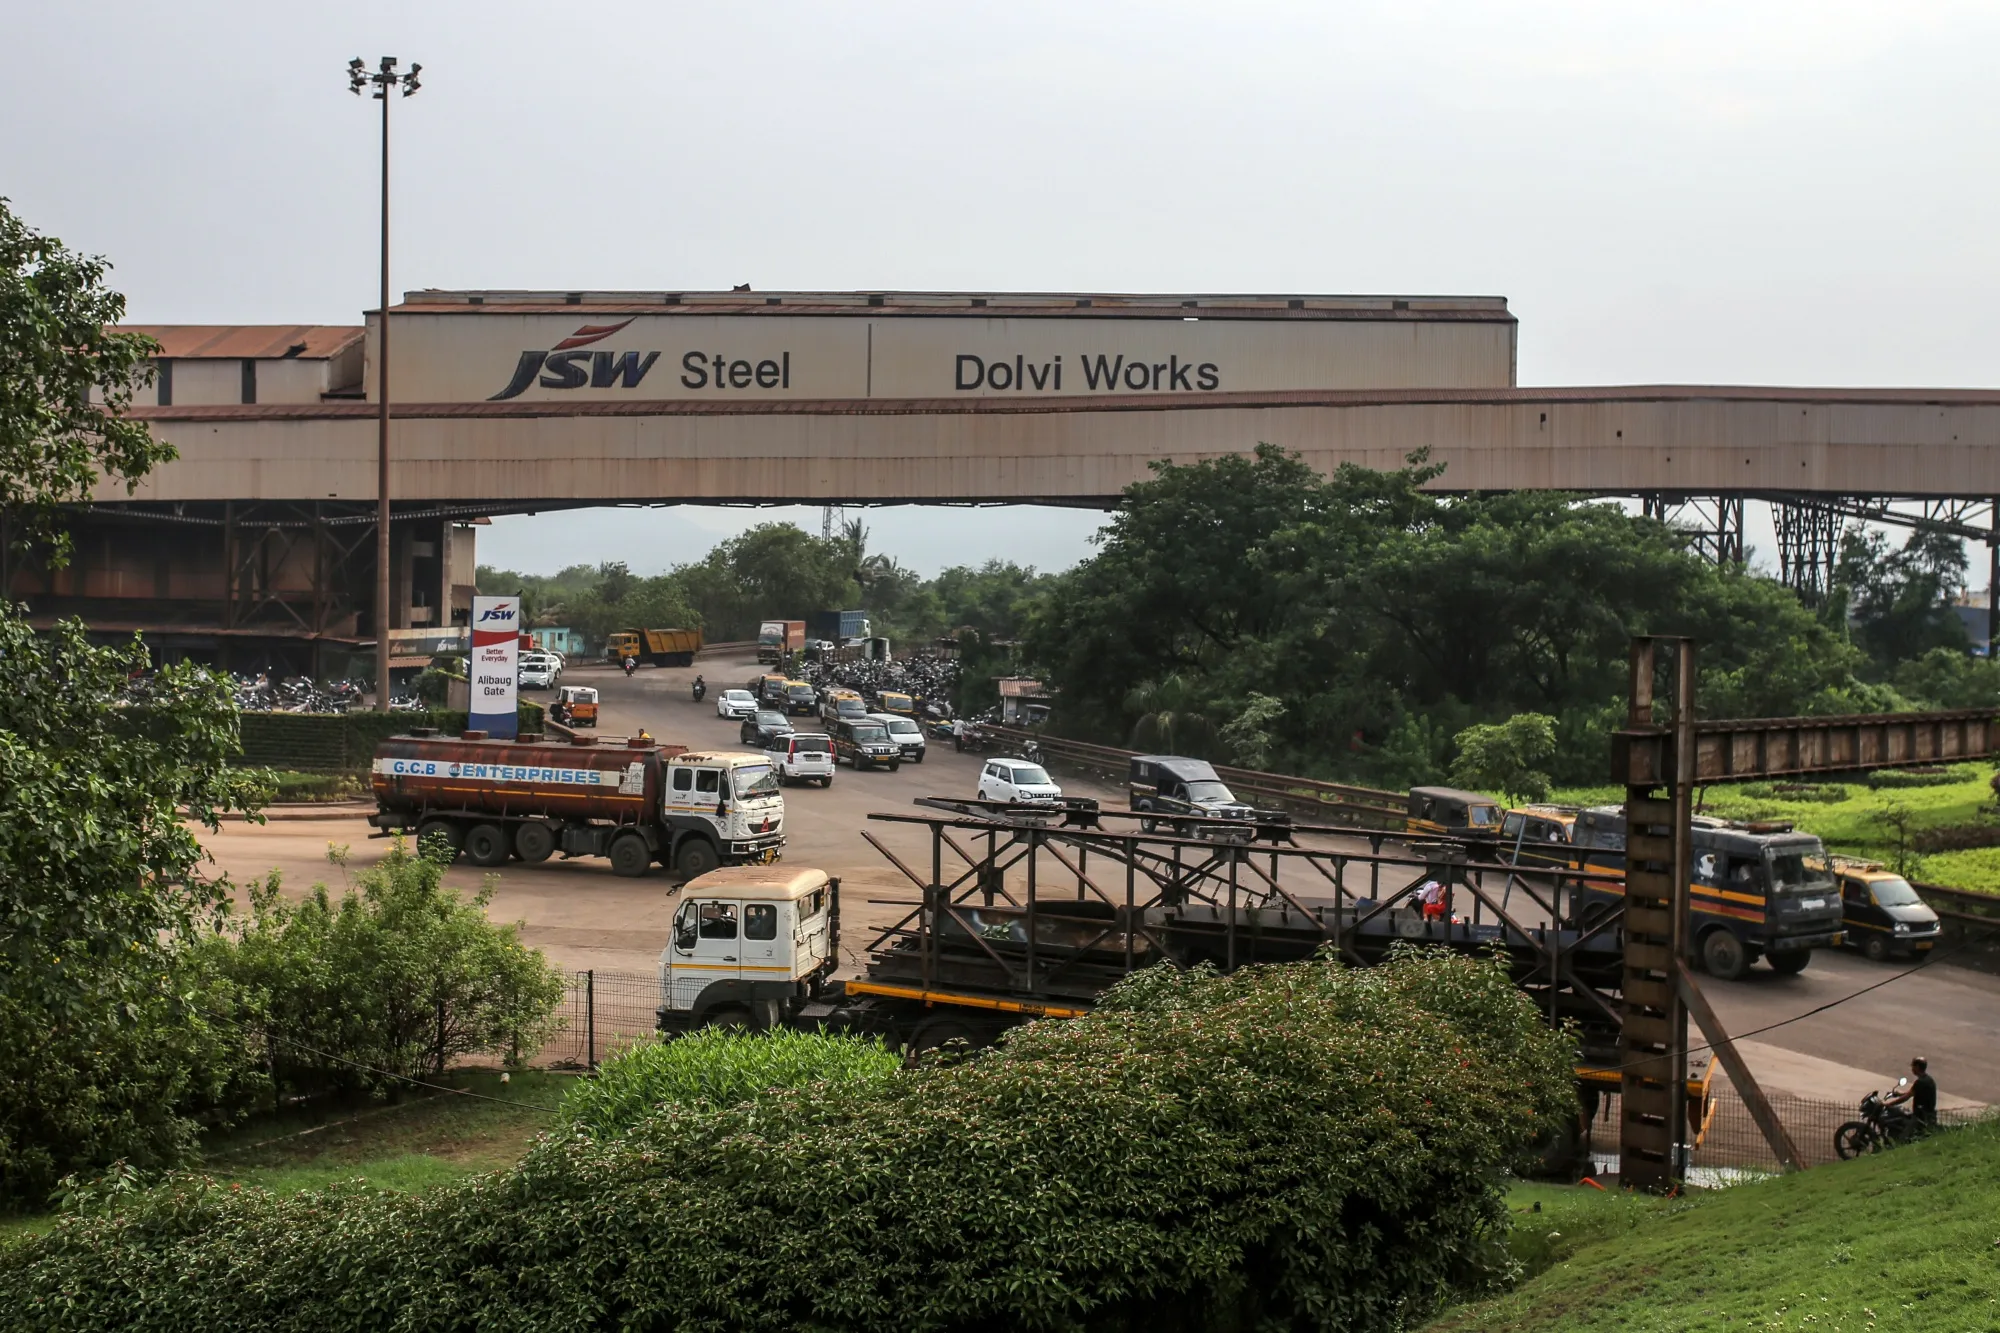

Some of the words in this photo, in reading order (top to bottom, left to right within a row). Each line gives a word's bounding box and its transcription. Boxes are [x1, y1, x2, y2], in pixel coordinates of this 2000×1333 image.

[486, 350, 662, 401] JSW
[681, 351, 790, 390] Steel
[955, 354, 1062, 391] Dolvi
[1081, 354, 1220, 391] Works
[478, 610, 516, 622] JSW
[481, 655, 508, 663] Everyday
[477, 676, 512, 686] Alibaug
[484, 687, 505, 696] Gate
[393, 761, 436, 775] G.C.B
[462, 764, 601, 784] ENTERPRISES
